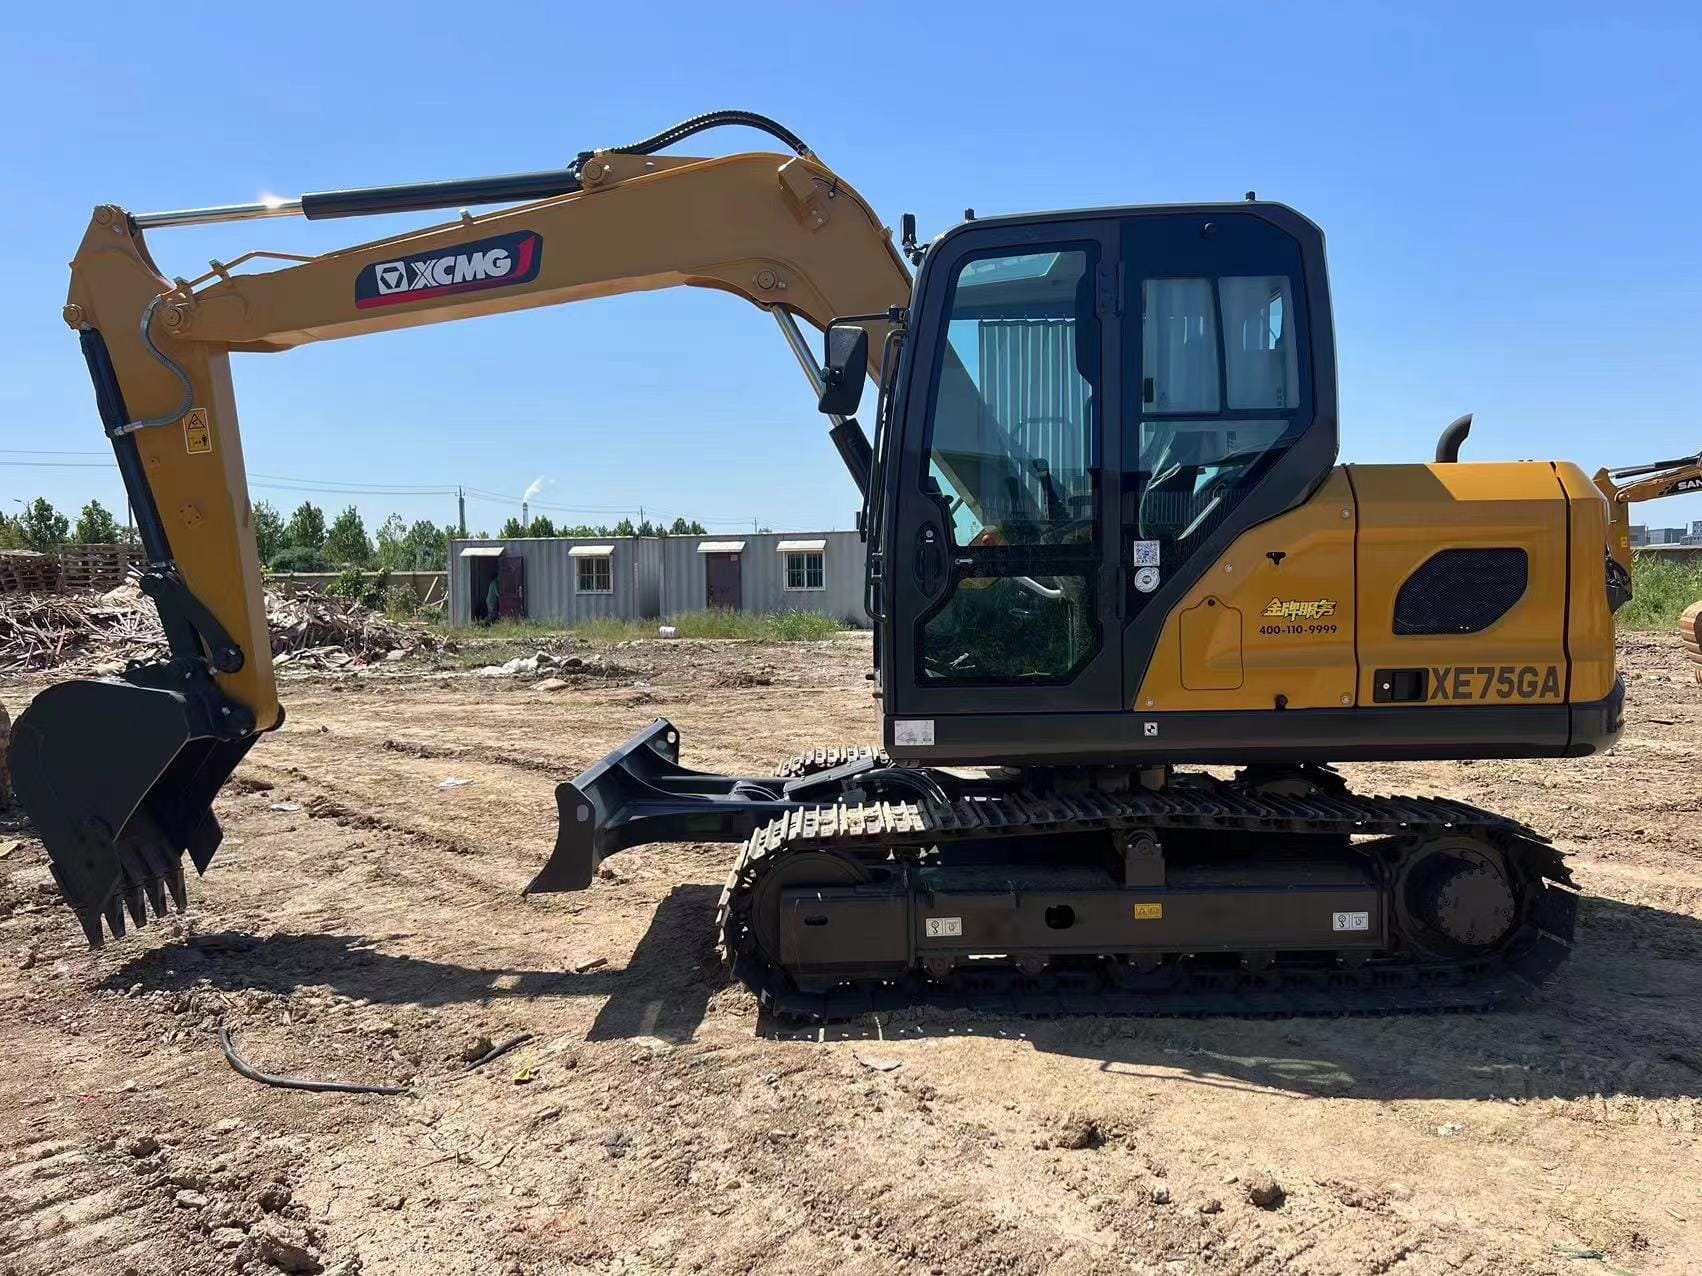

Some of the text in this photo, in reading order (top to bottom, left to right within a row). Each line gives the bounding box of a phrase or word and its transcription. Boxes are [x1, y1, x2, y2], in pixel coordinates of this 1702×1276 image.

[409, 248, 512, 290] XCMG
[1261, 597, 1337, 621] 金牌服务
[1259, 625, 1337, 635] 400-110-9999
[1429, 665, 1561, 700] XE75GA
